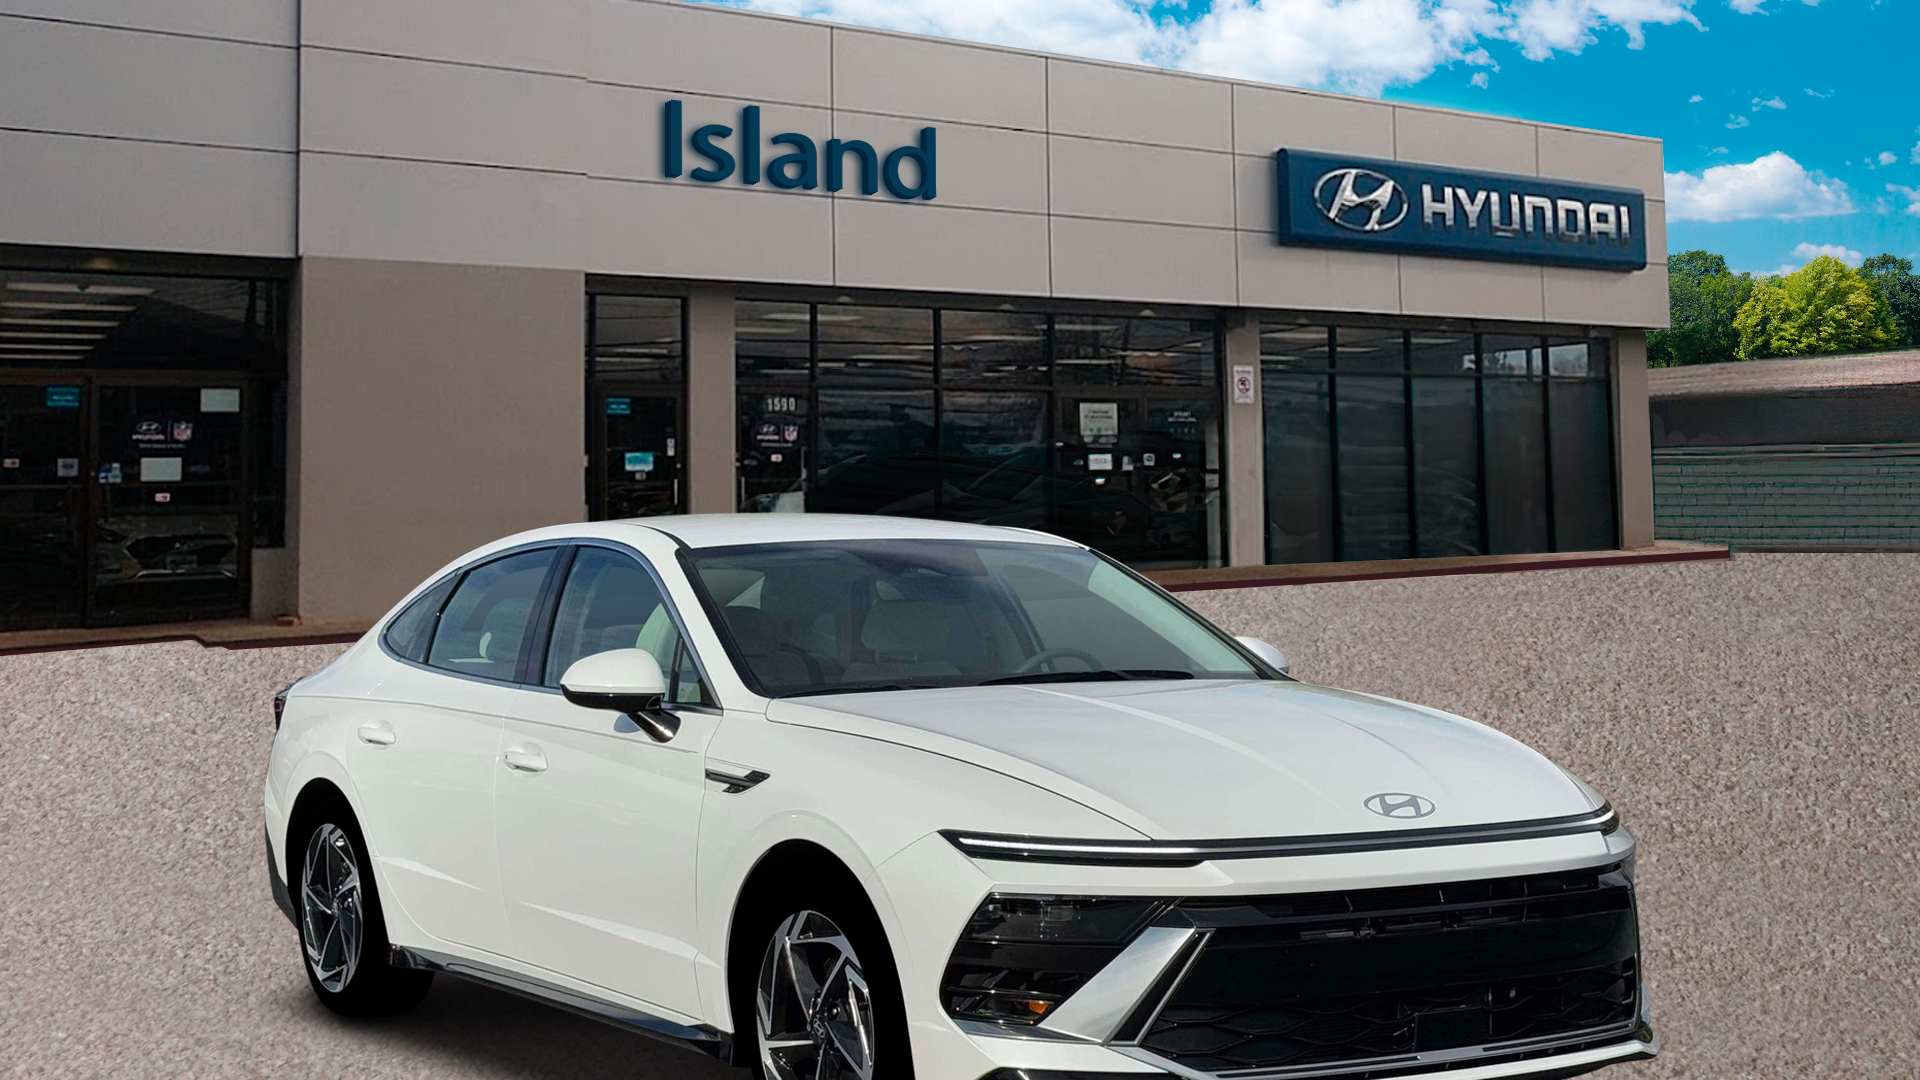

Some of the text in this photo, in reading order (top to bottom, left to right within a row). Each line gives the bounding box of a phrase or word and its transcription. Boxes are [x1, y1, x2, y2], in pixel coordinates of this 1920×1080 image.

[664, 99, 937, 201] Island
[1421, 184, 1631, 247] HYUNDAI
[767, 397, 796, 411] 1590
